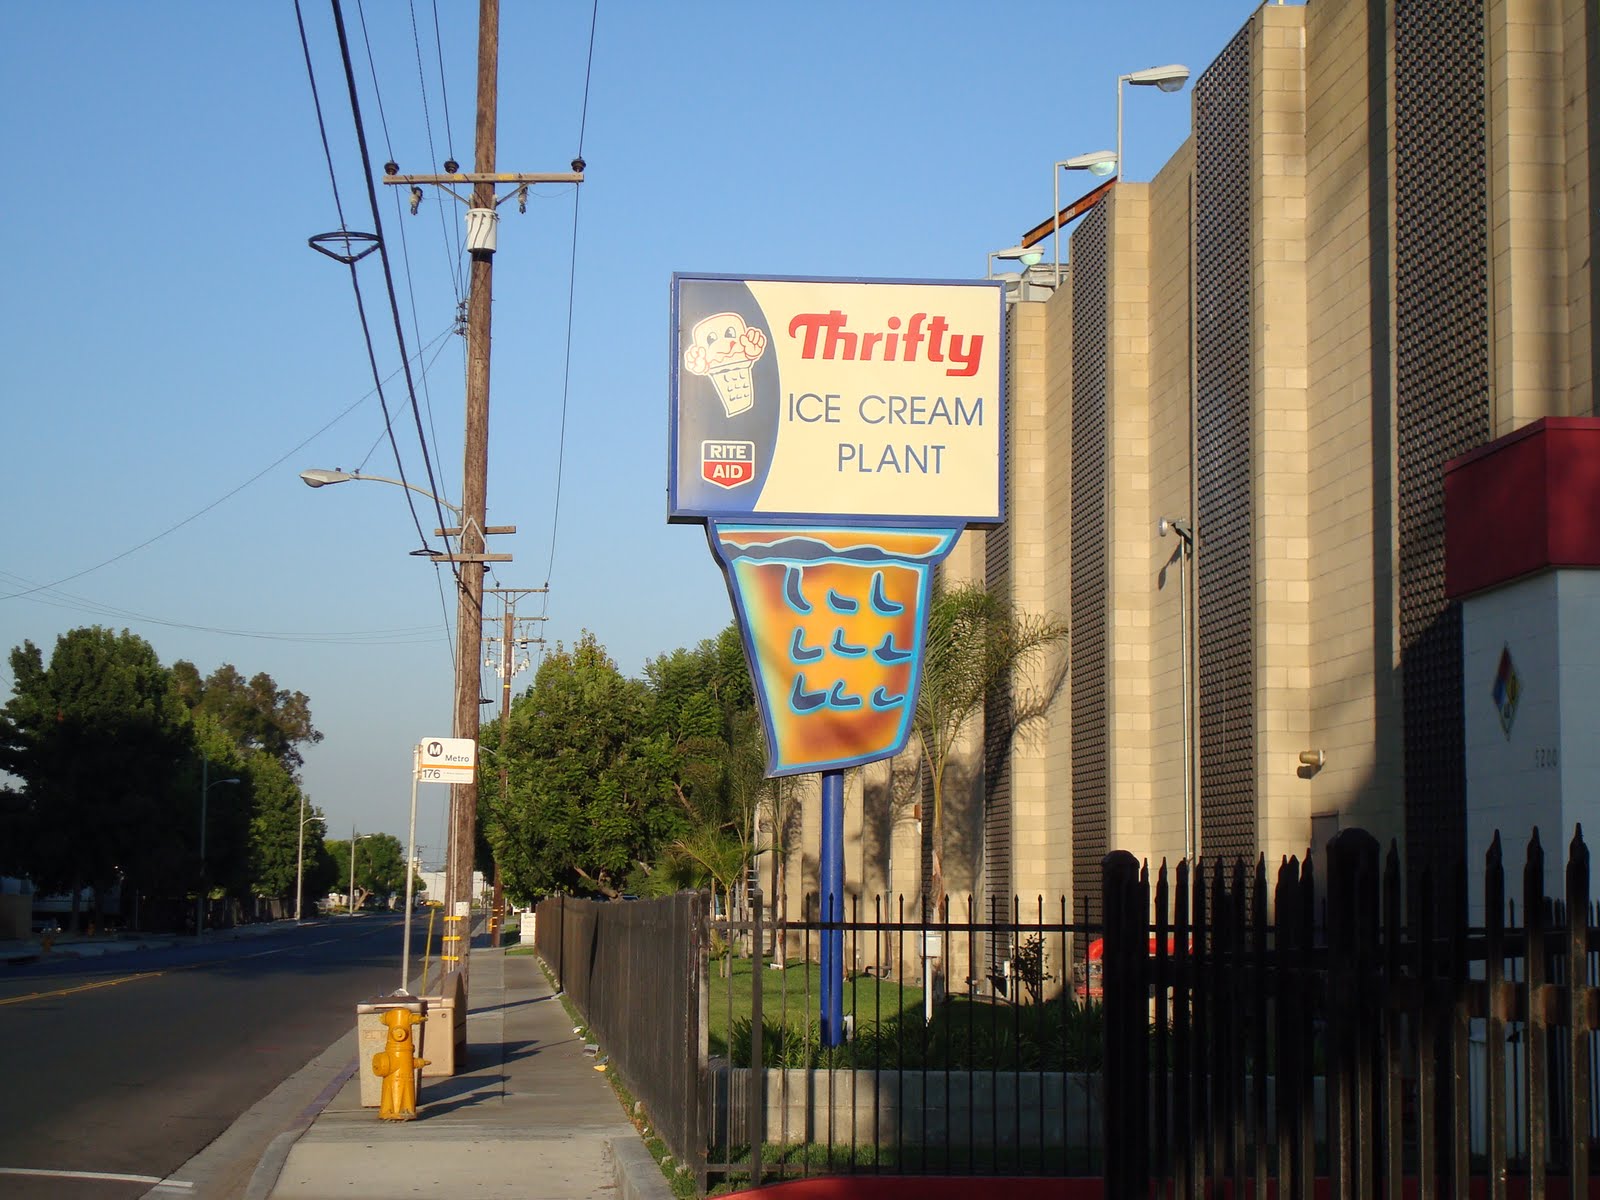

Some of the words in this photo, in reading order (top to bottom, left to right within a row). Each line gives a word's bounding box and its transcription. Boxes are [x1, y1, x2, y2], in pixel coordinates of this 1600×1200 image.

[788, 310, 984, 377] Thrifty
[788, 393, 841, 423] ICE
[858, 394, 983, 426] CREAM
[710, 444, 747, 459] RITE
[838, 443, 946, 474] PLANT
[712, 464, 744, 479] AID
[428, 743, 442, 756] M
[445, 754, 470, 763] Metro
[422, 769, 441, 779] 176
